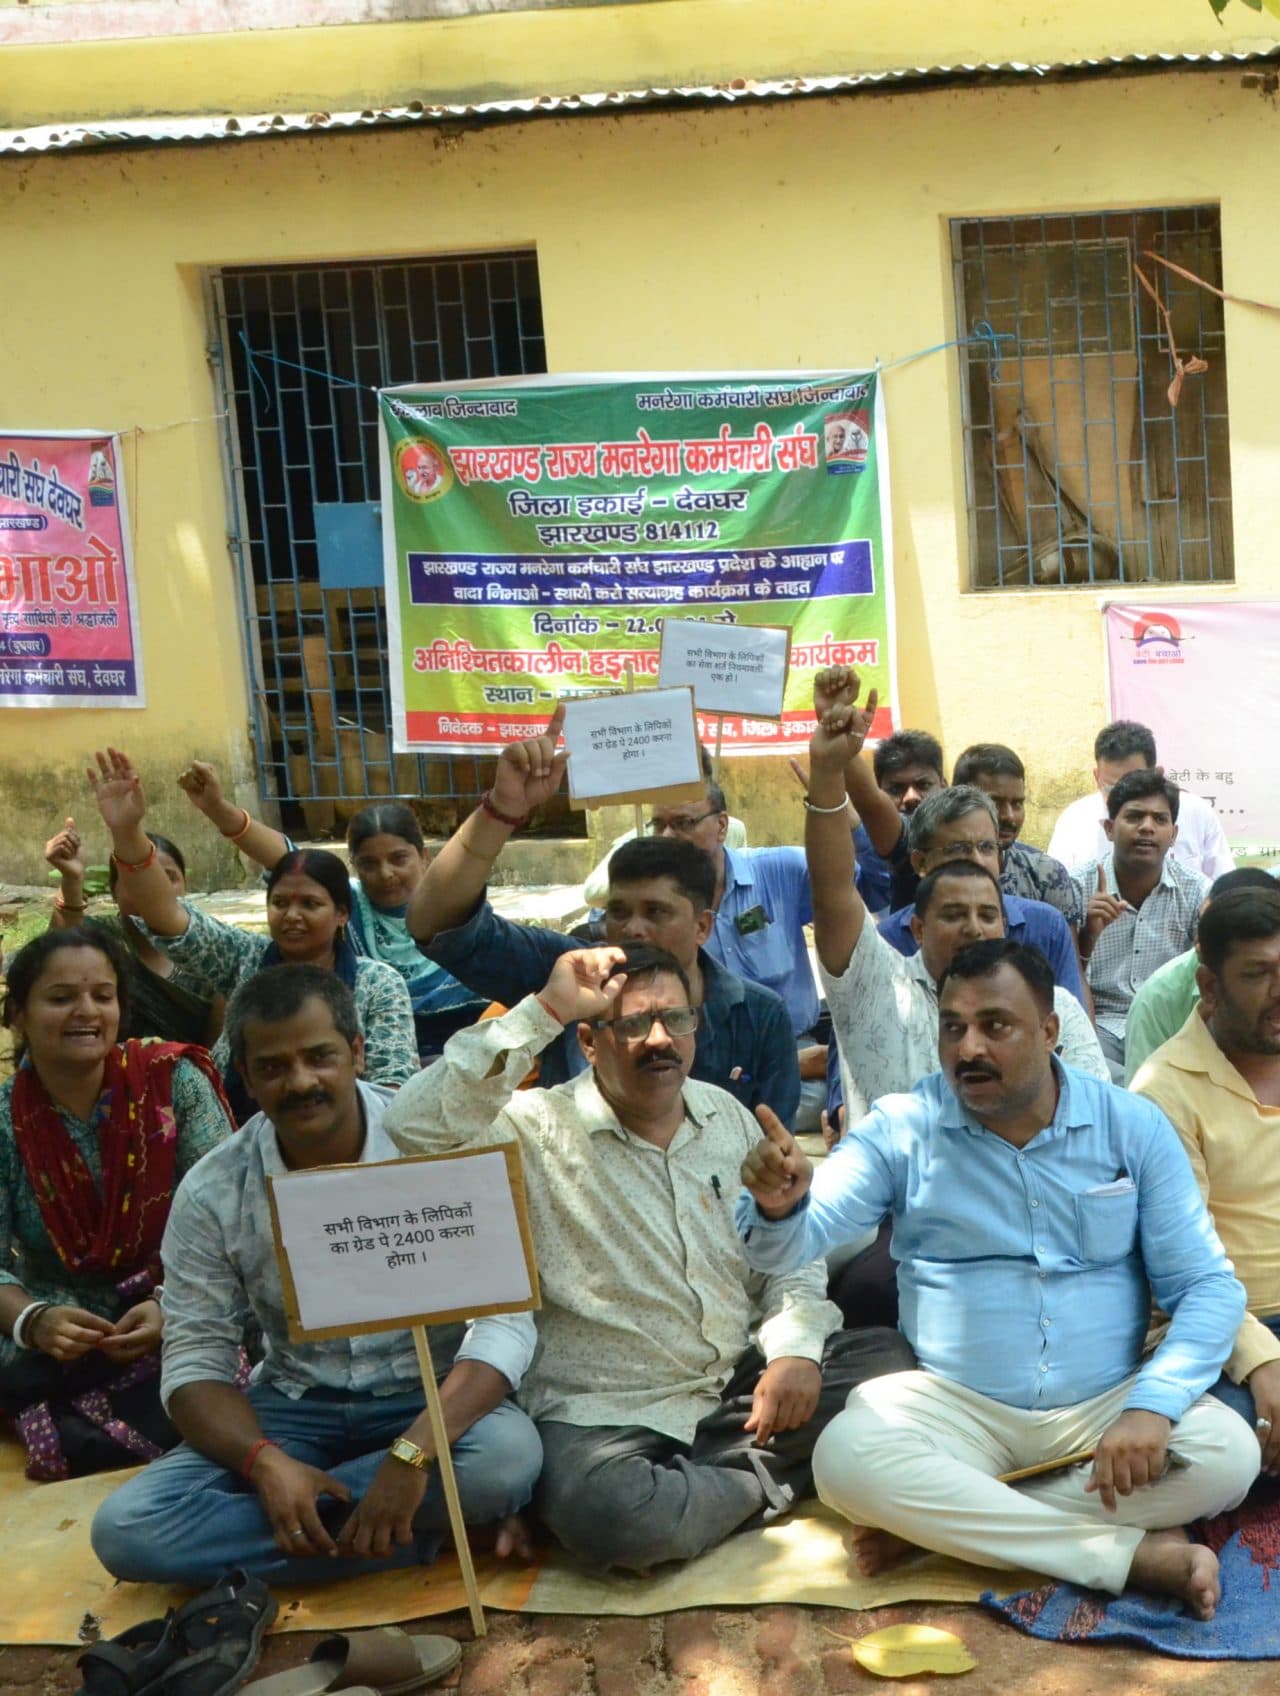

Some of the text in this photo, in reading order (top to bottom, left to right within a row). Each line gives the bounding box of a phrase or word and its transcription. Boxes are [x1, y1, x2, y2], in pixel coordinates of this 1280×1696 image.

[637, 388, 693, 411] मनरेगा
[697, 385, 760, 410] कर्मचारी
[765, 386, 795, 407] संघ
[448, 422, 818, 486] झारखण्ड राज्य मनरेगा कर्मचारी संघ
[24, 460, 45, 508] संघ
[49, 467, 83, 529] देवघर
[508, 487, 750, 518] जिला इकाई देवघर
[537, 520, 720, 547] झारखण्ड 814112
[422, 561, 478, 576] झारखण्ड
[481, 561, 517, 576] राज्य
[520, 558, 564, 576] मनरेगा
[567, 556, 621, 576] कर्मचारी
[625, 556, 650, 574] संघ
[653, 557, 715, 576] झारखण्ड
[718, 553, 755, 575] प्रदेश
[758, 551, 777, 570] के
[454, 586, 483, 601] वादा
[486, 582, 539, 601] निभाओ
[554, 583, 592, 601] स्थायी
[595, 584, 622, 601] करो
[688, 580, 750, 600] कार्यक्रम
[753, 577, 772, 596] के
[774, 581, 811, 596] तहत
[61, 608, 72, 627] को
[534, 612, 599, 635] दिनांक
[24, 662, 64, 686] कर्मचारी
[93, 664, 126, 687] देवघर
[484, 686, 534, 704] स्थान
[437, 716, 484, 736] निवेदक
[590, 727, 607, 739] सभी
[608, 725, 633, 737] विभाग
[634, 722, 642, 733] के
[592, 740, 603, 751] का
[627, 735, 650, 747] 2400
[652, 732, 673, 743] करना
[622, 749, 639, 761] होगा
[1196, 767, 1210, 781] के
[323, 1201, 473, 1237] सभी विभाग के लिपिकों
[329, 1224, 475, 1255] का ग्रेड पे 2400 करना
[385, 1251, 416, 1270] होगा
